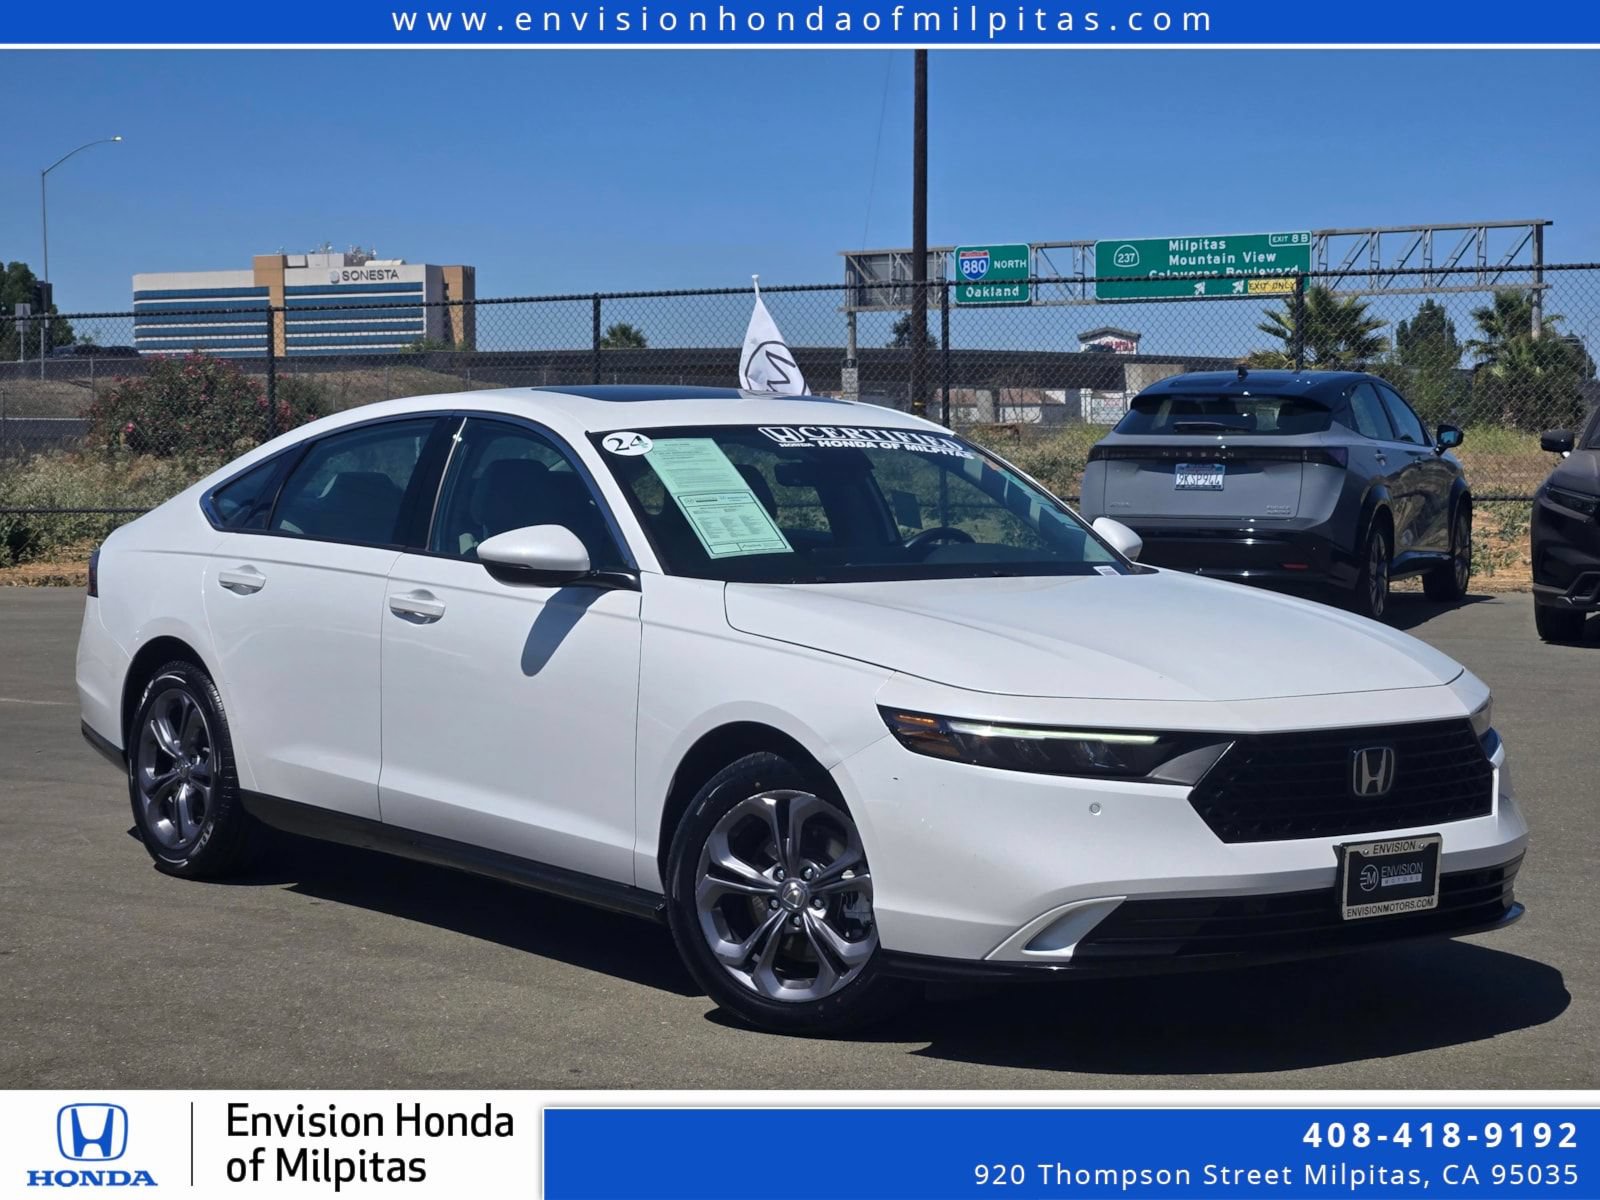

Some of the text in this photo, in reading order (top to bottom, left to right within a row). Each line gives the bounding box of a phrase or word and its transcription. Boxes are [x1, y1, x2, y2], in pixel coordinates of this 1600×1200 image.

[1169, 239, 1226, 253] Milpitas
[993, 260, 1027, 269] NORTH
[1118, 253, 1135, 263] 237
[1169, 251, 1276, 266] Mountain View
[963, 259, 987, 274] 880
[342, 269, 400, 281] SONESTA
[965, 286, 1019, 298] Oakland
[1249, 281, 1296, 290] EXIT ONLY
[798, 427, 963, 450] CERTIFIED
[817, 440, 974, 459] HONDA OF MILPITAS
[1373, 842, 1416, 854] ENVISION
[1381, 862, 1423, 877] ENVISION
[1347, 898, 1433, 917] ENVISIONMOTORS.COM
